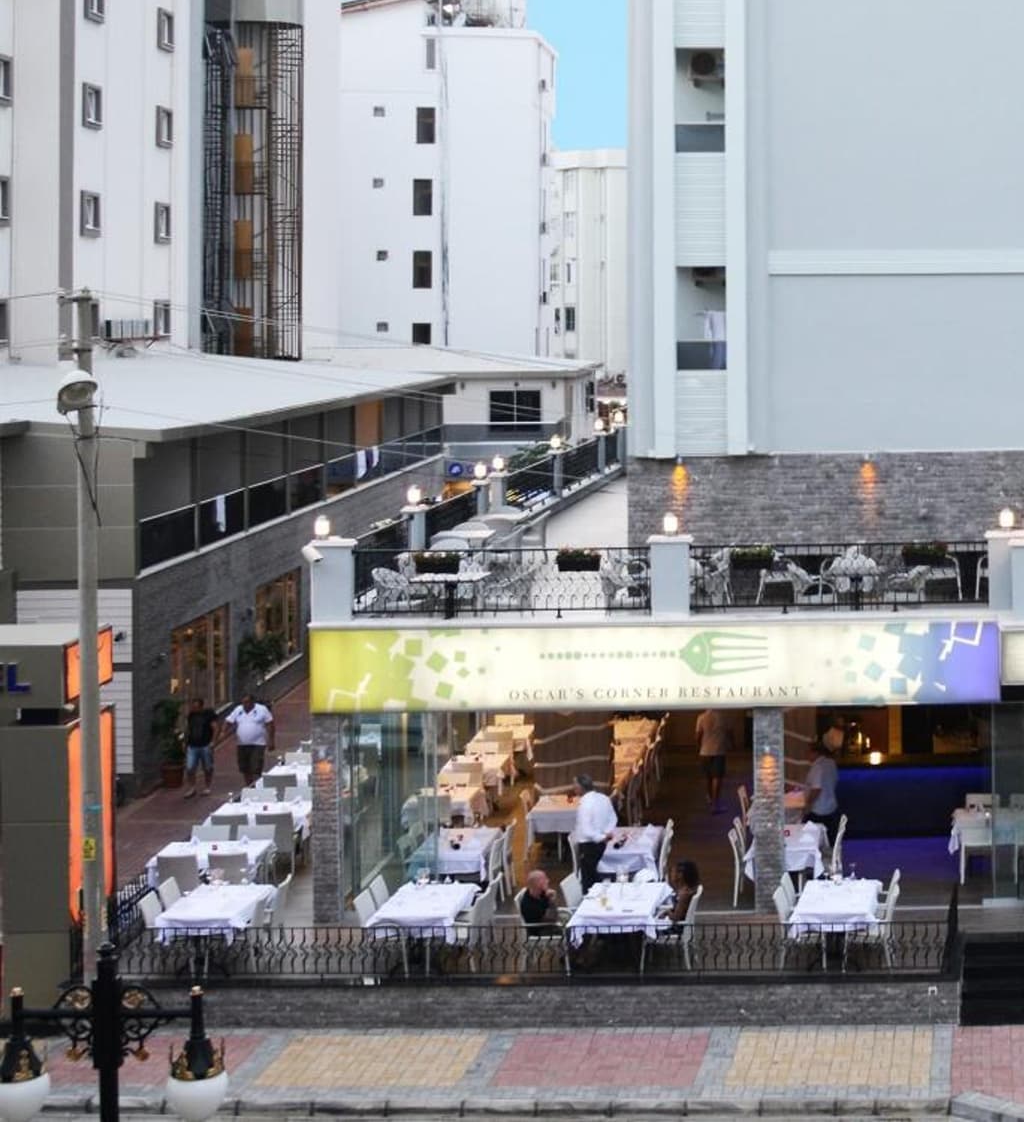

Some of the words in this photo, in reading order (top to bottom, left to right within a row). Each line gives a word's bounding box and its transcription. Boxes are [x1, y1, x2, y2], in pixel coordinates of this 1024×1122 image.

[508, 687, 585, 701] OSCAR'S
[593, 687, 669, 700] CORNER
[678, 685, 802, 699] RESTAURANT
